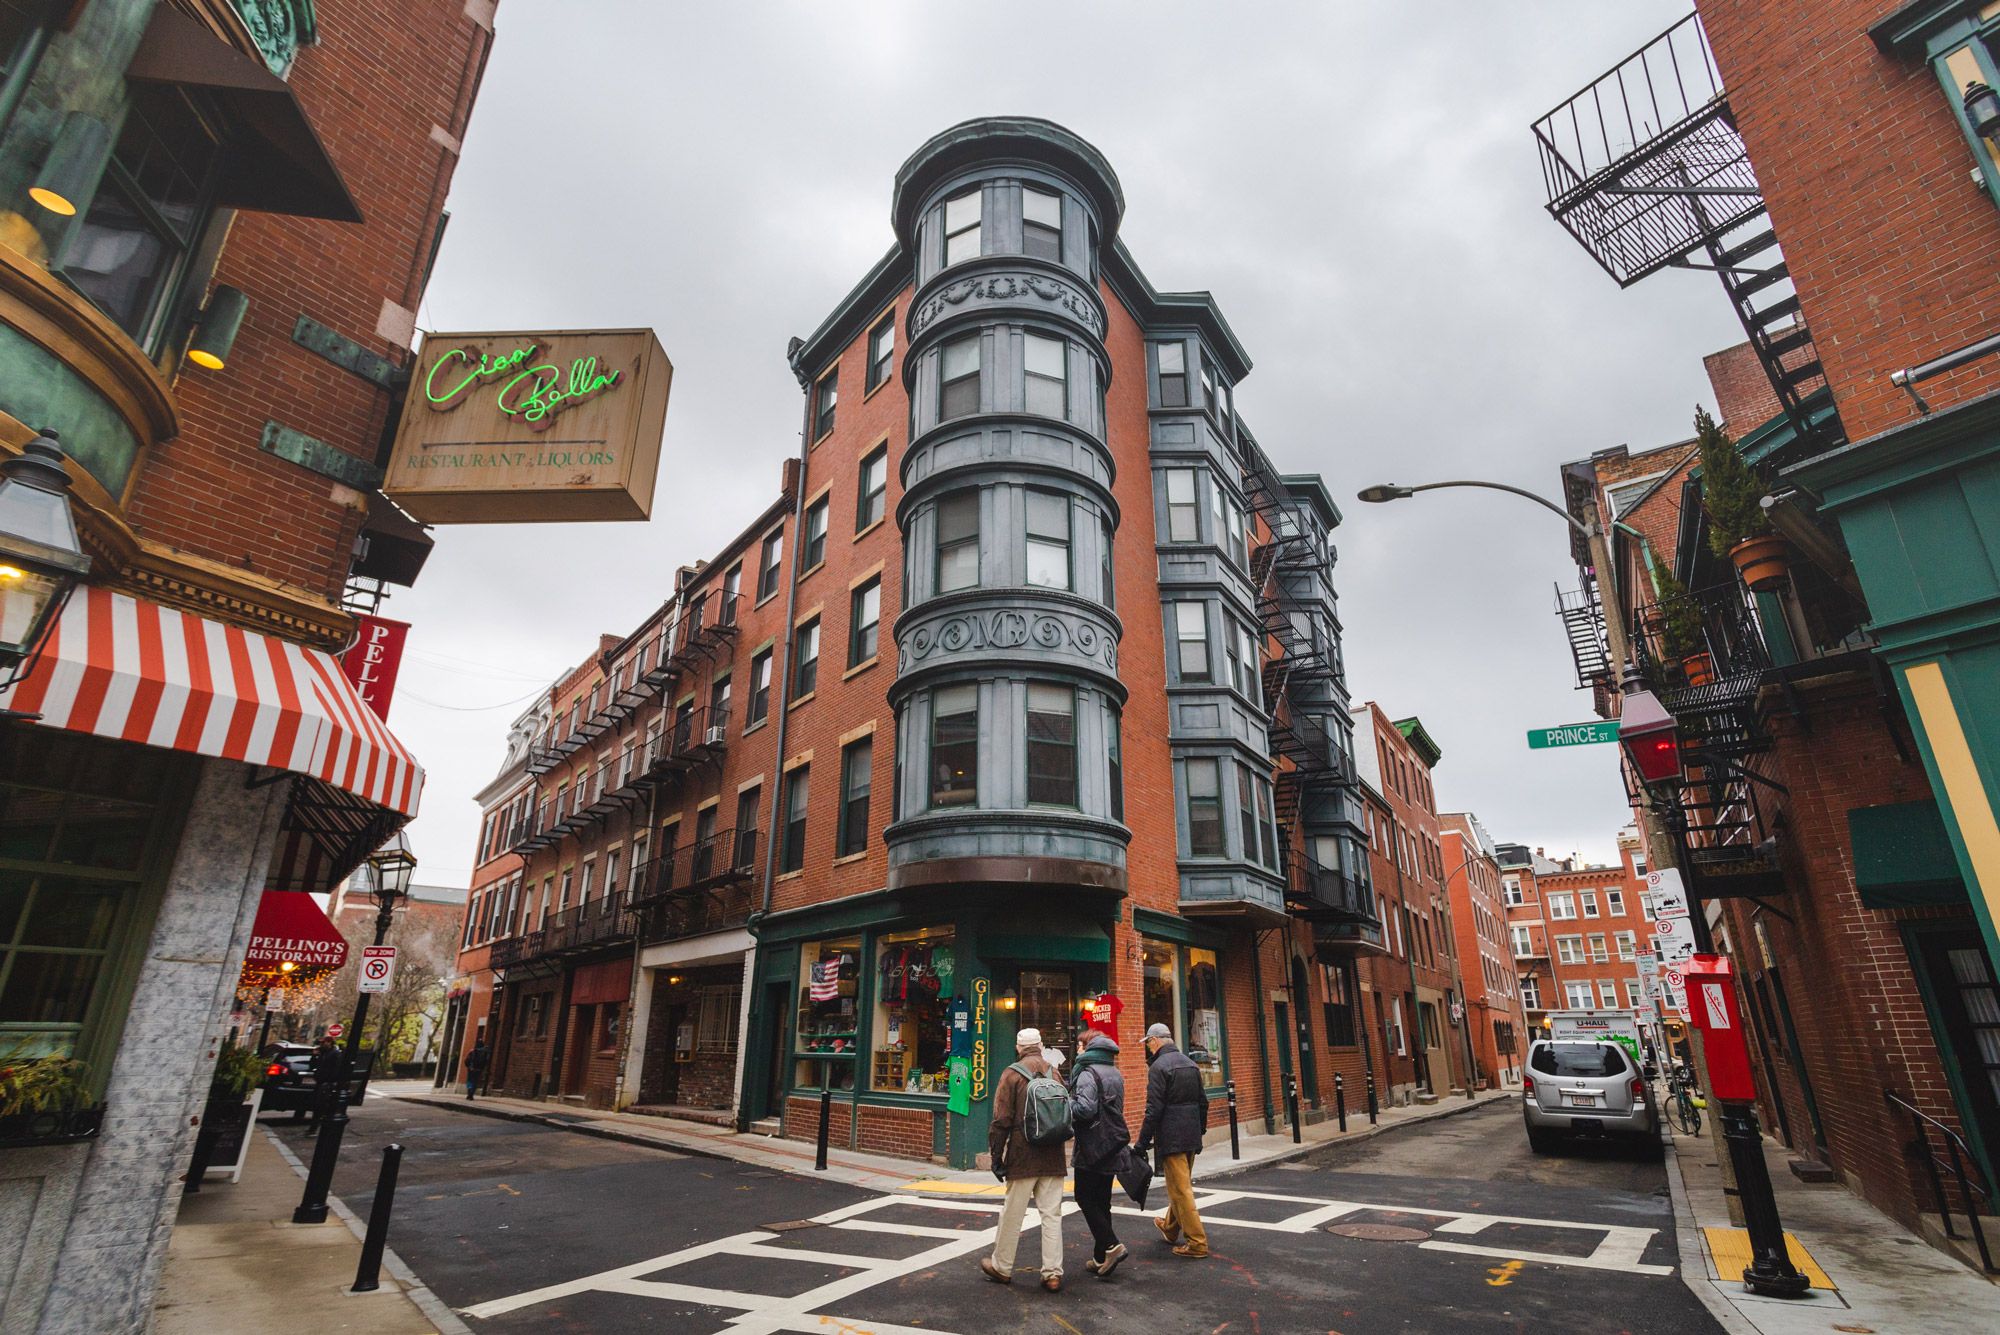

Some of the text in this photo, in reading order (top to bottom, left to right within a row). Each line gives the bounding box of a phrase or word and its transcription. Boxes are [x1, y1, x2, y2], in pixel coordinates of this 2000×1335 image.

[425, 345, 537, 403] Ciao
[497, 356, 620, 422] Bella
[407, 452, 615, 468] RESTAURANT LIQUORS
[1546, 727, 1608, 746] PRINCE ST
[251, 936, 345, 954] PELLINO'S
[248, 949, 342, 965] RISTORANTE
[1707, 985, 1722, 1007] FIRE
[972, 980, 987, 1097] GIFT SHOP
